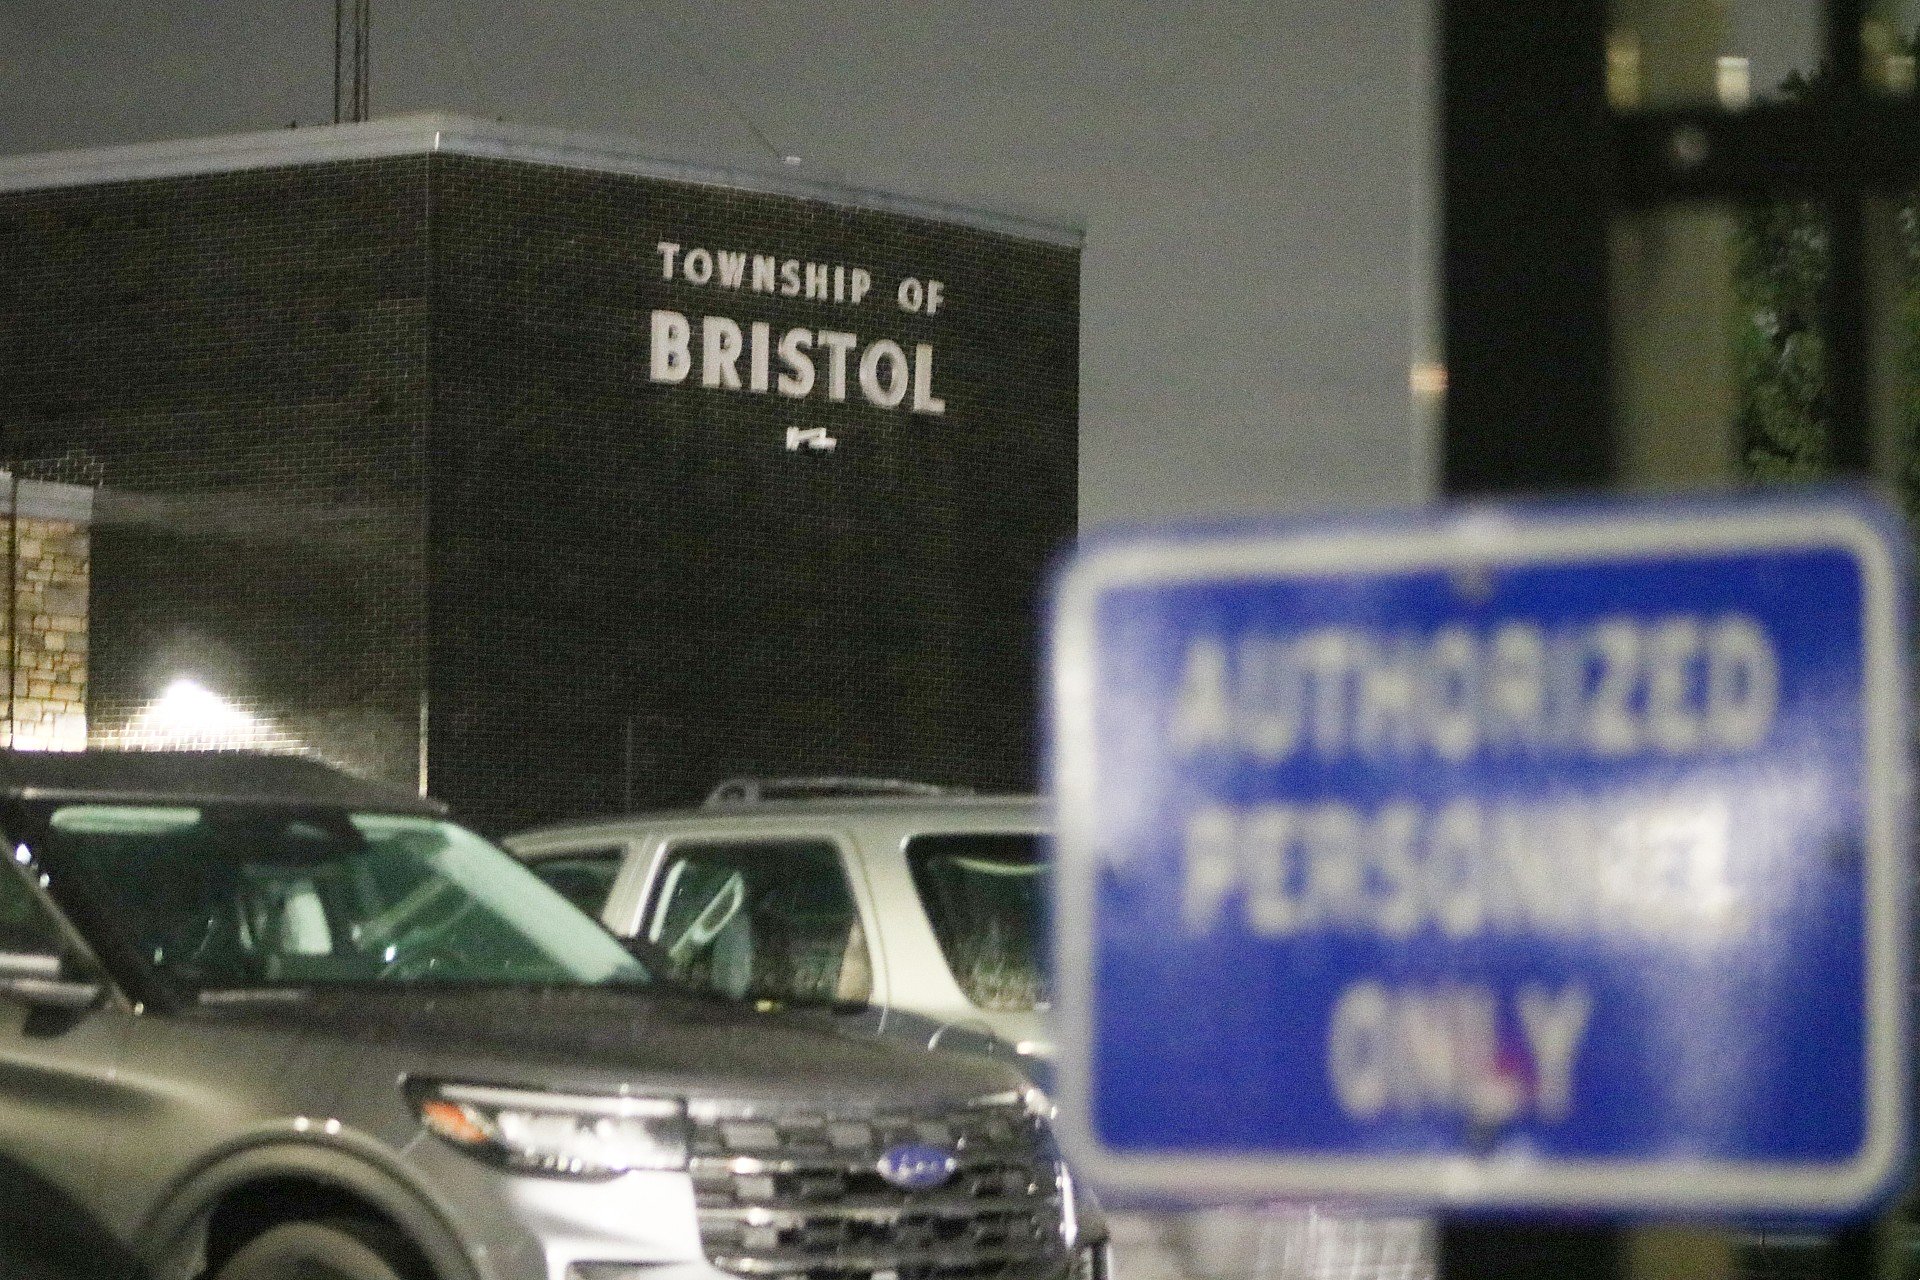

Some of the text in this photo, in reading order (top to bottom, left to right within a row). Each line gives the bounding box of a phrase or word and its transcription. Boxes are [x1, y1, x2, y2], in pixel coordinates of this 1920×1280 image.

[656, 241, 945, 316] TOWNSHIP OF
[650, 309, 946, 415] BRISTOL
[1168, 614, 1779, 764] AUTHORIZED
[1328, 981, 1592, 1122] ONLY
